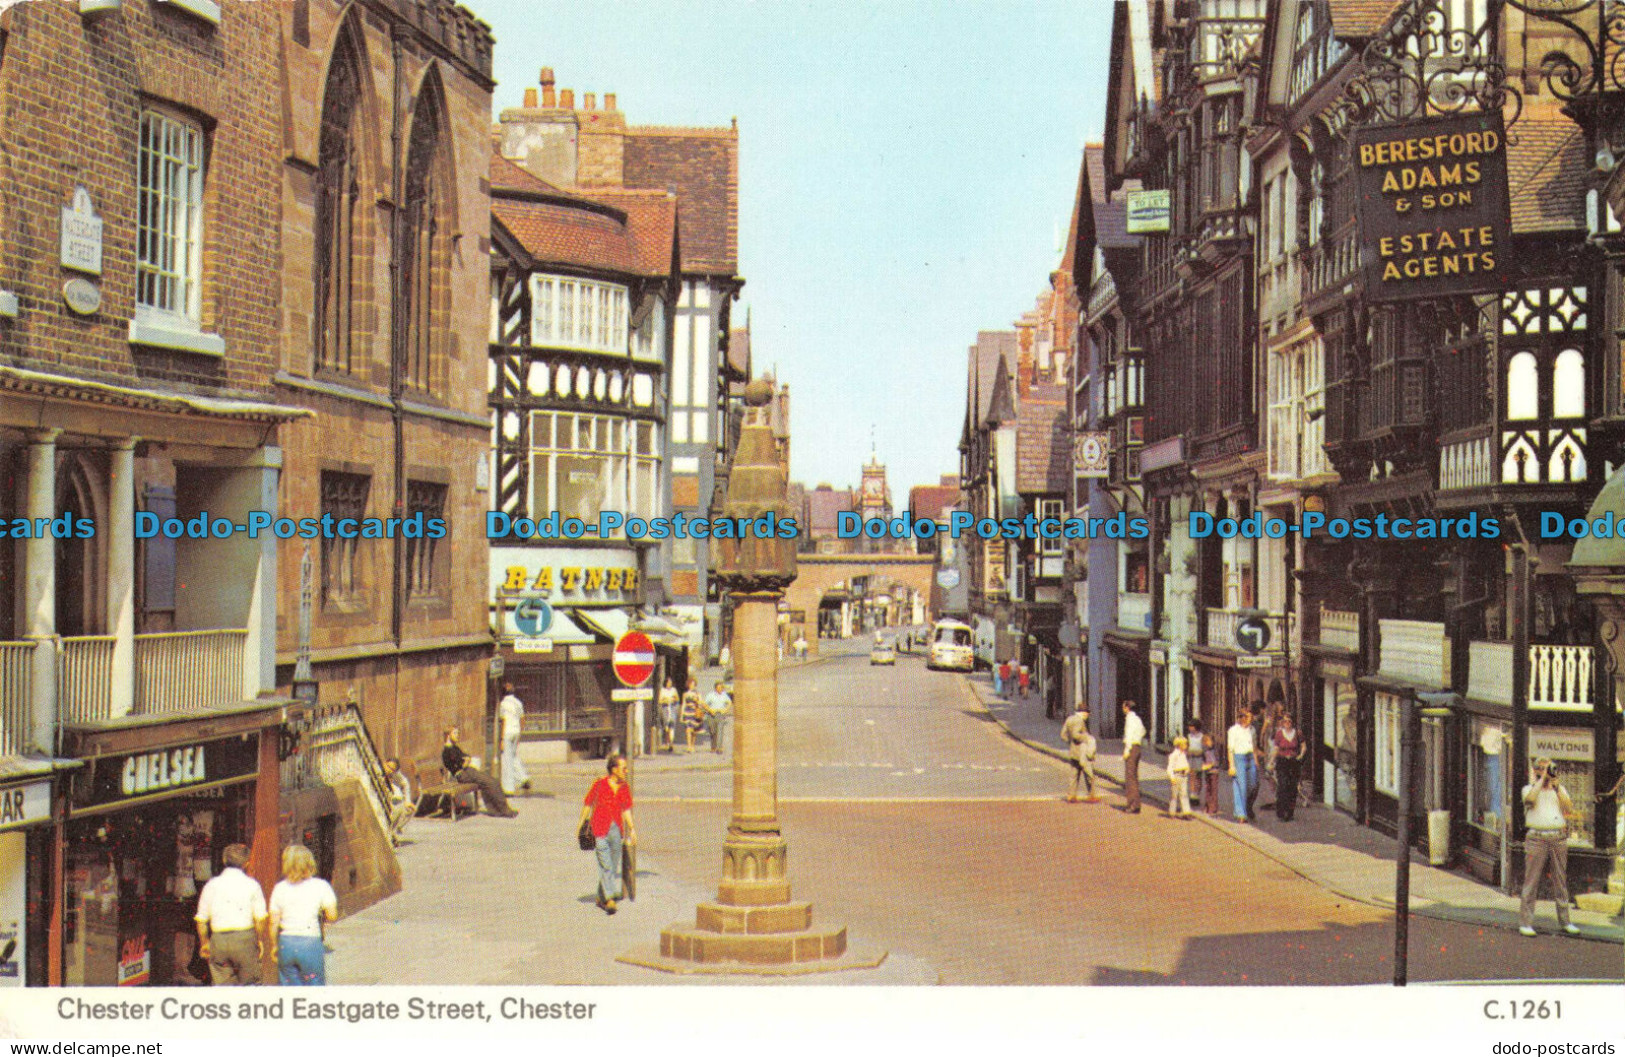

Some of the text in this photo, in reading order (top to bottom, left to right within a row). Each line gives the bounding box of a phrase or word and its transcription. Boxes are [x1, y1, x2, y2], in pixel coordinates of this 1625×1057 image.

[1360, 130, 1499, 167] BERESFORD
[1382, 161, 1481, 193] ADAMS
[1395, 190, 1473, 212] & SON
[1380, 226, 1494, 257] ESTATE
[1382, 251, 1496, 281] AGENTS
[502, 566, 640, 591] RATNER
[1536, 740, 1589, 753] WALTONS
[121, 746, 206, 795] CHELSEA
[0, 789, 25, 824] AR
